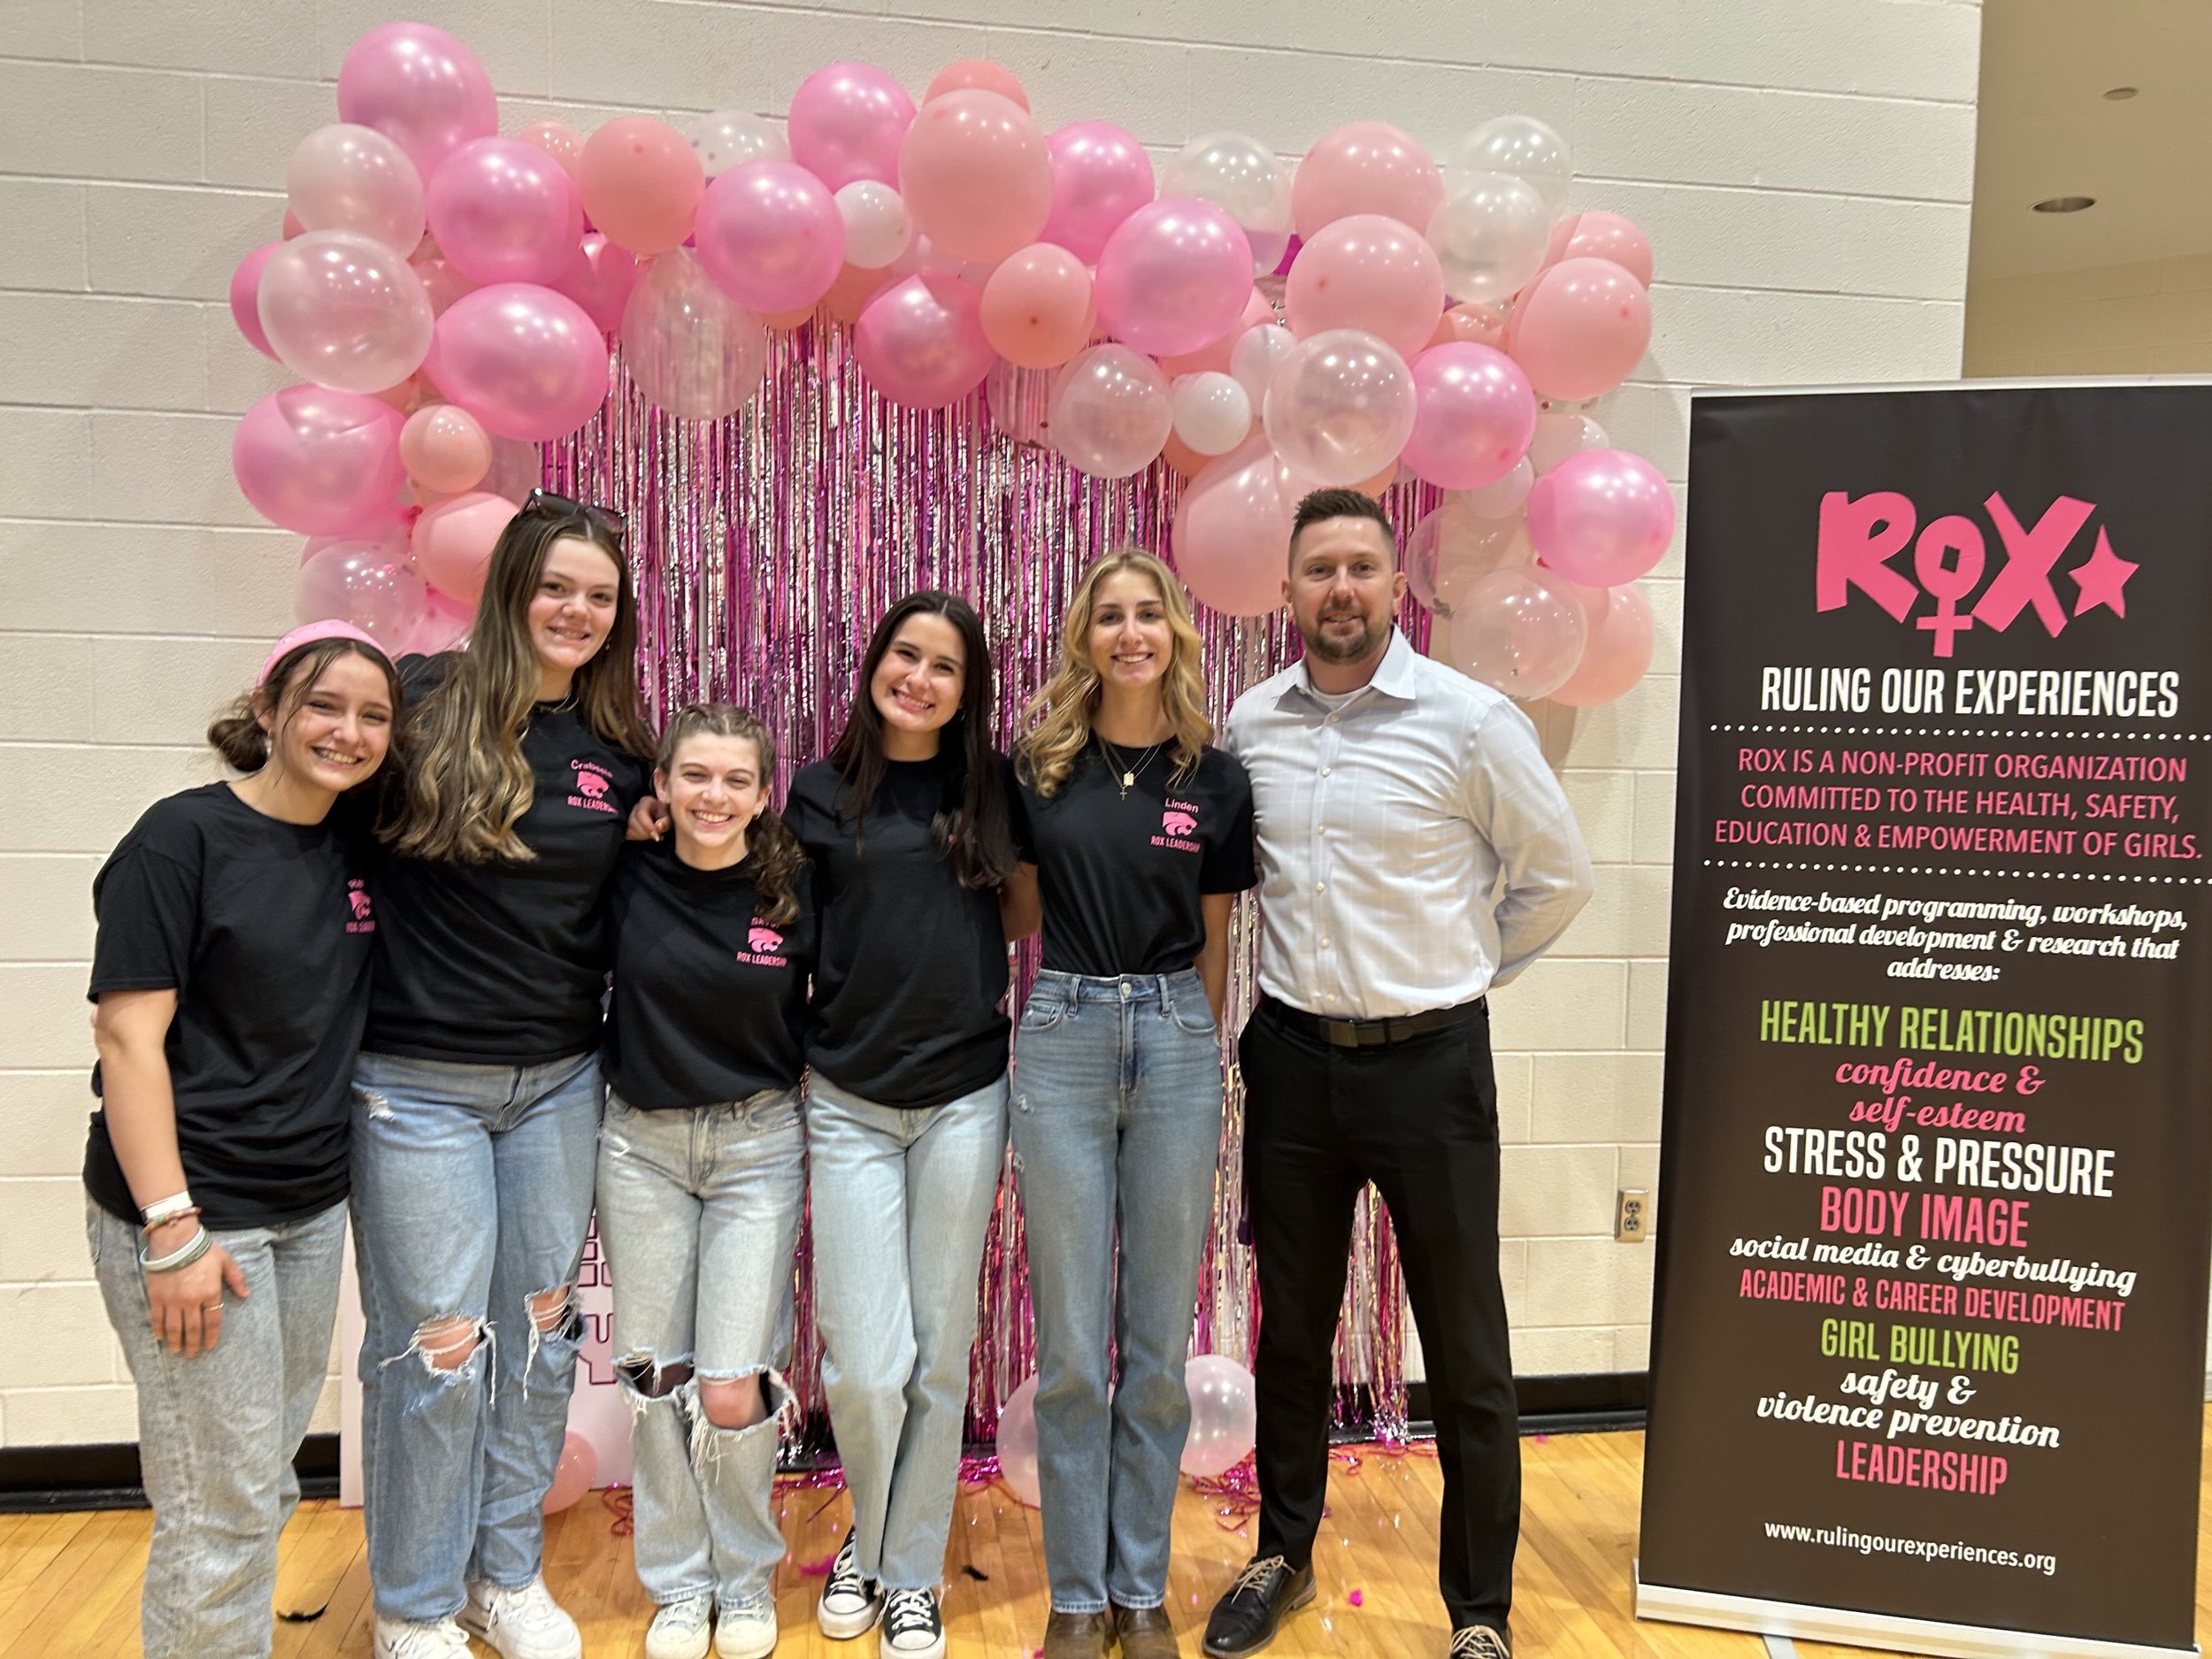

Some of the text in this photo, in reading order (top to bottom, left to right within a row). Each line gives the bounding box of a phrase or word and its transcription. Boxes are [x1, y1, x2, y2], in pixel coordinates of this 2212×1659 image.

[1762, 667, 2178, 718] RULING OUR EXPERIENCES
[1740, 749, 2186, 781] ROX IS A NON-PROFIT ORGANIZATION
[1741, 785, 2178, 824] COMMITTED TO THE HEALTH, SAFETY,
[1150, 835, 1165, 847] ROX
[1716, 820, 2201, 858] EDUCATION & EMPOWERMENT OF GIRLS.
[1724, 887, 2187, 933] Evidence-based programming, workshops,
[736, 951, 751, 963] ROX
[1725, 919, 2180, 959] professional development & research that
[1887, 957, 2001, 981] addresses:
[1761, 1001, 2143, 1064] HEALTHY RELATIONSHIPS
[1836, 1058, 2046, 1094] confidence &
[1849, 1095, 2025, 1133] self-esteem
[1764, 1126, 2115, 1197] STRESS & PRESSURE
[1821, 1186, 2030, 1248] BODY IMAGE
[1730, 1235, 2137, 1297] social media & cyberbullying
[1740, 1269, 2125, 1332] ACADEMIC & CAREER DEVELOPMENT
[1822, 1318, 2019, 1374] GIRL BULLYING
[1840, 1369, 1977, 1409] safety &
[1757, 1392, 2060, 1448] violence prevention
[1837, 1440, 2008, 1495] LEADERSHIP
[1765, 1522, 2055, 1576] www.rulingourexperiences.org
